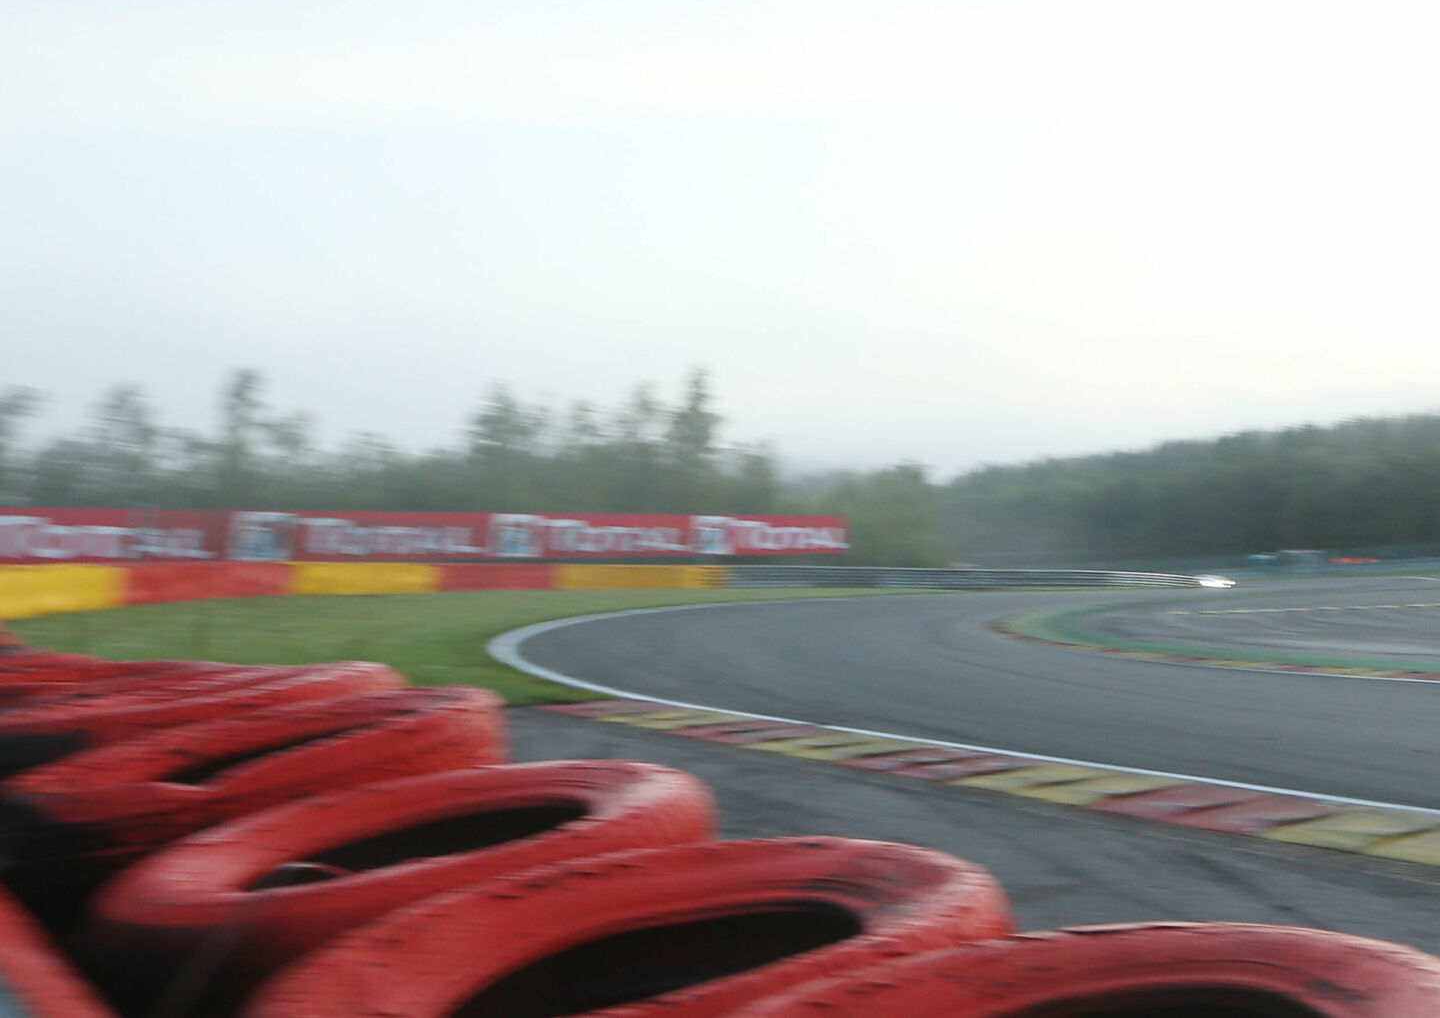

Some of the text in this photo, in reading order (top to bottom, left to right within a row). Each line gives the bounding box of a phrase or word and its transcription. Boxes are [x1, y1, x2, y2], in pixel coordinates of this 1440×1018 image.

[297, 517, 487, 555] TOTAL
[541, 519, 690, 551] TOTAL
[730, 520, 851, 549] TOTAL
